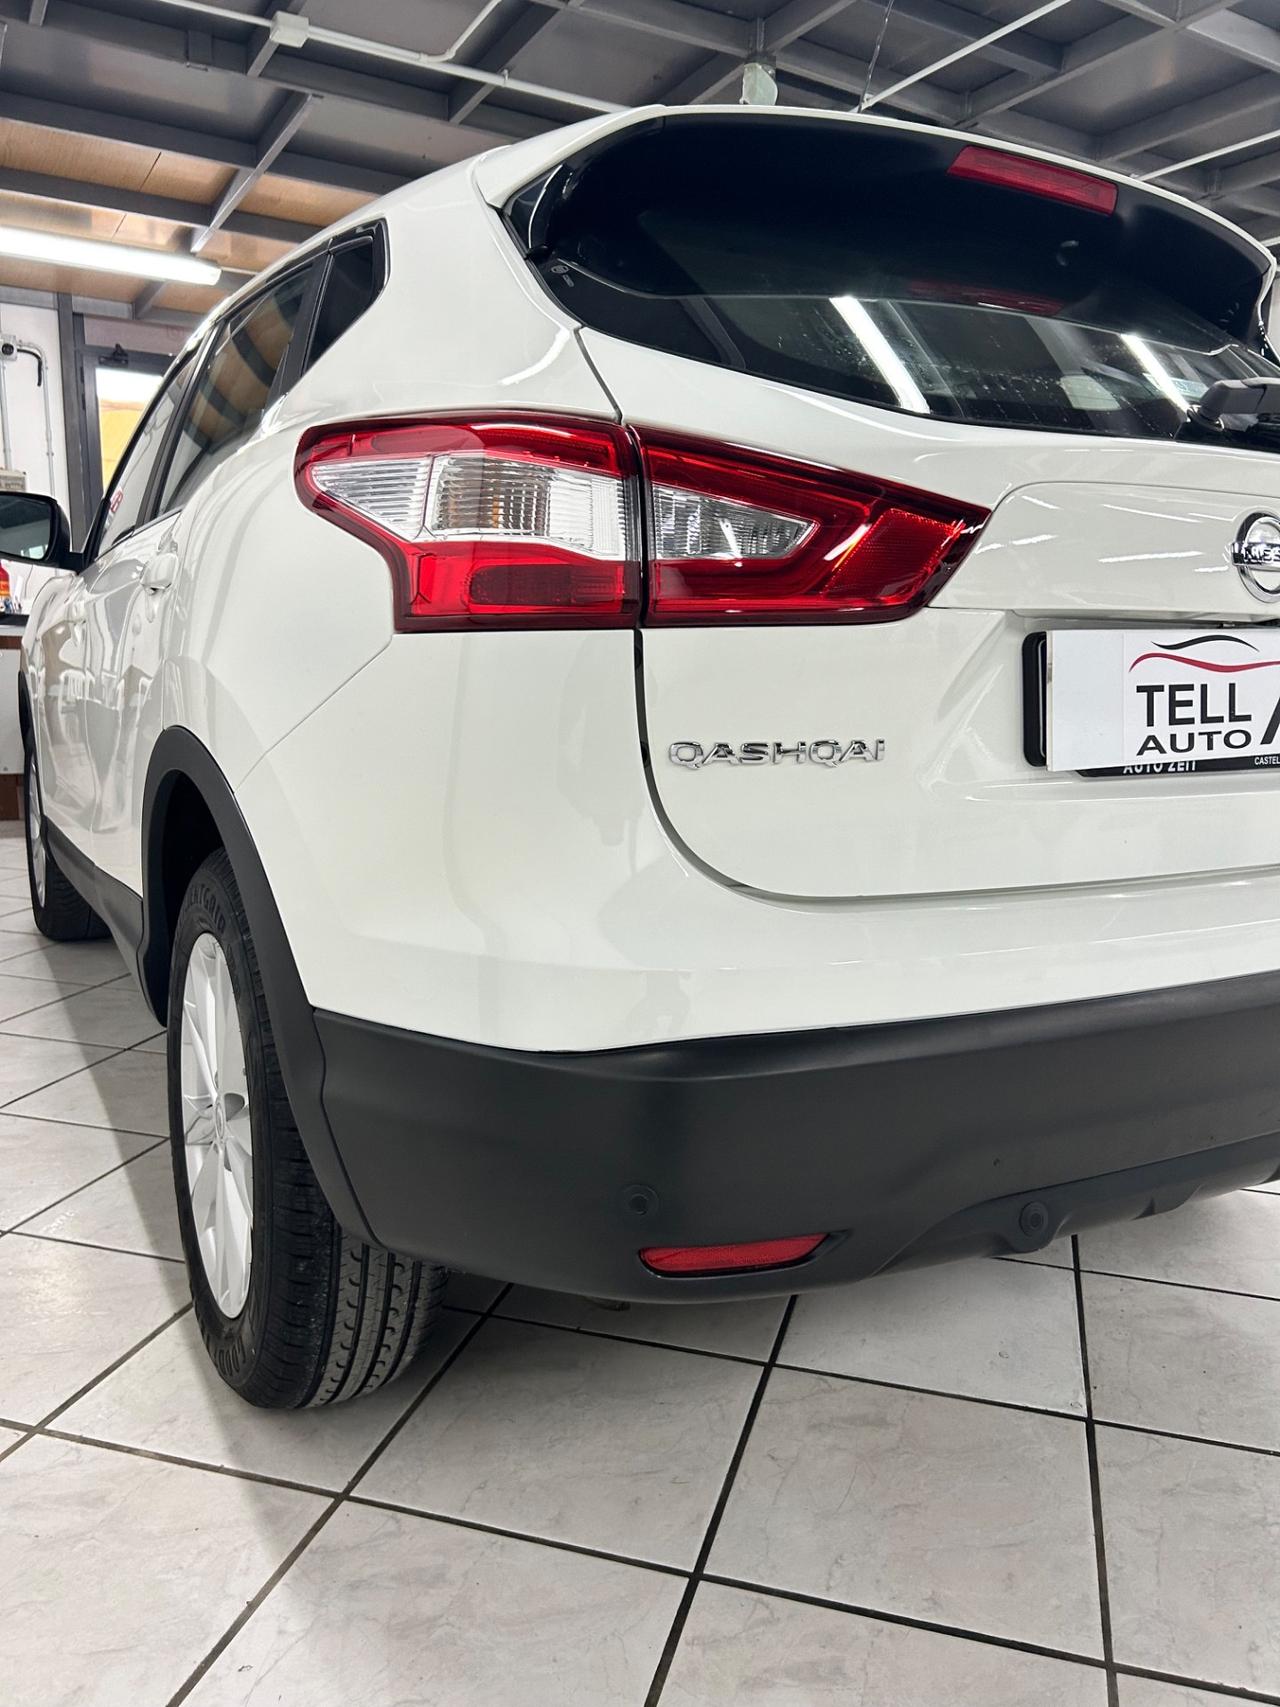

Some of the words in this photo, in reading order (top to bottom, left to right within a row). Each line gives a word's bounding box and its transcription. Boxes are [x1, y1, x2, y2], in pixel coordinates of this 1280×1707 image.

[1136, 683, 1252, 727] TELL
[669, 739, 885, 769] QASHQAI
[1136, 729, 1252, 756] AUTO
